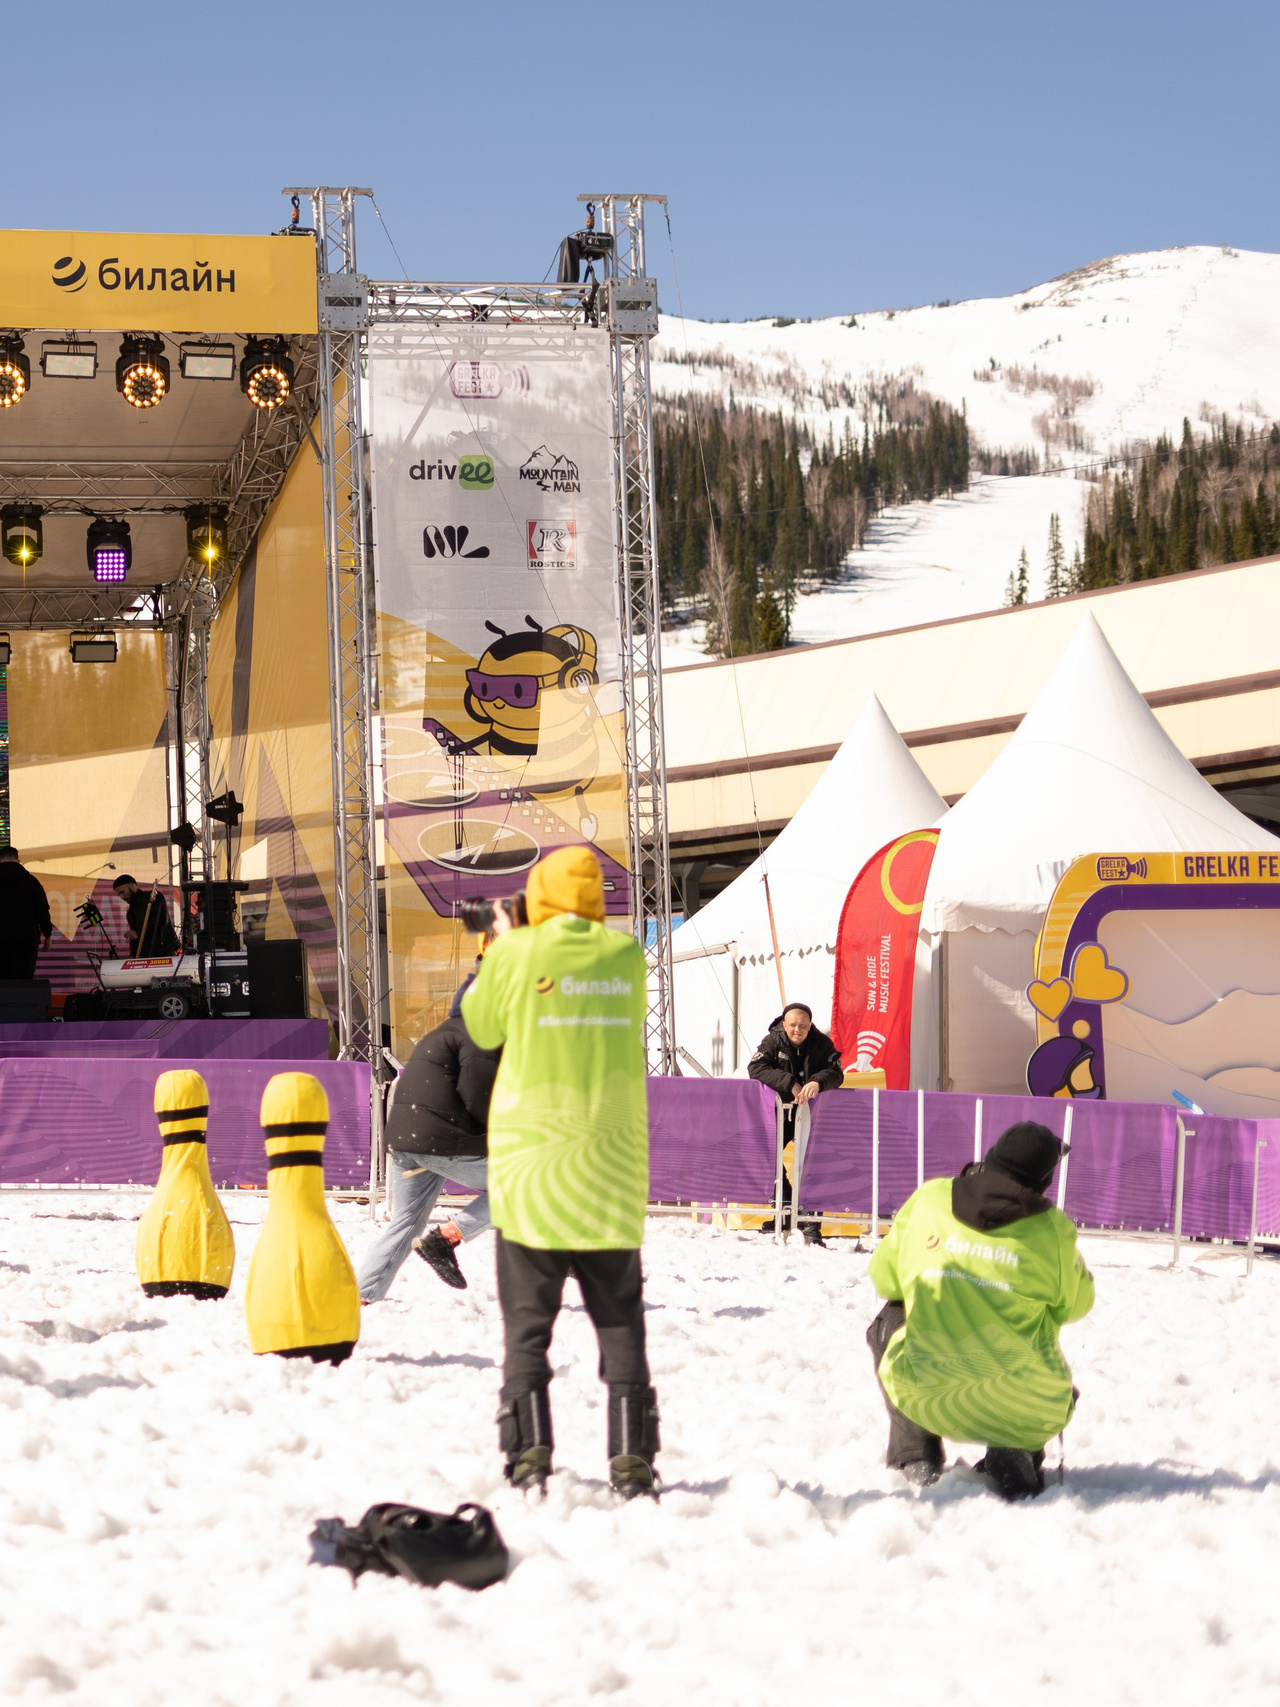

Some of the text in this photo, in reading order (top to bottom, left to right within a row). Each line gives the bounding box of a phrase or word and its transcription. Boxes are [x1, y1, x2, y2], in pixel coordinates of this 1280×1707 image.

[98, 257, 236, 293] билайн
[457, 367, 496, 380] GRELKA
[459, 381, 482, 394] FEST
[409, 459, 495, 484] drivee
[519, 468, 579, 481] MOUNTAIN
[553, 481, 581, 493] MAN
[1101, 860, 1126, 869] GRELKA
[1102, 869, 1118, 878] FEST
[1184, 856, 1280, 878] GRELKA FE
[866, 955, 877, 1011] SUN & RIDE
[879, 933, 891, 1013] MUSIC FESTIVAL
[561, 975, 632, 996] билайн
[945, 1235, 1020, 1268] билайн
